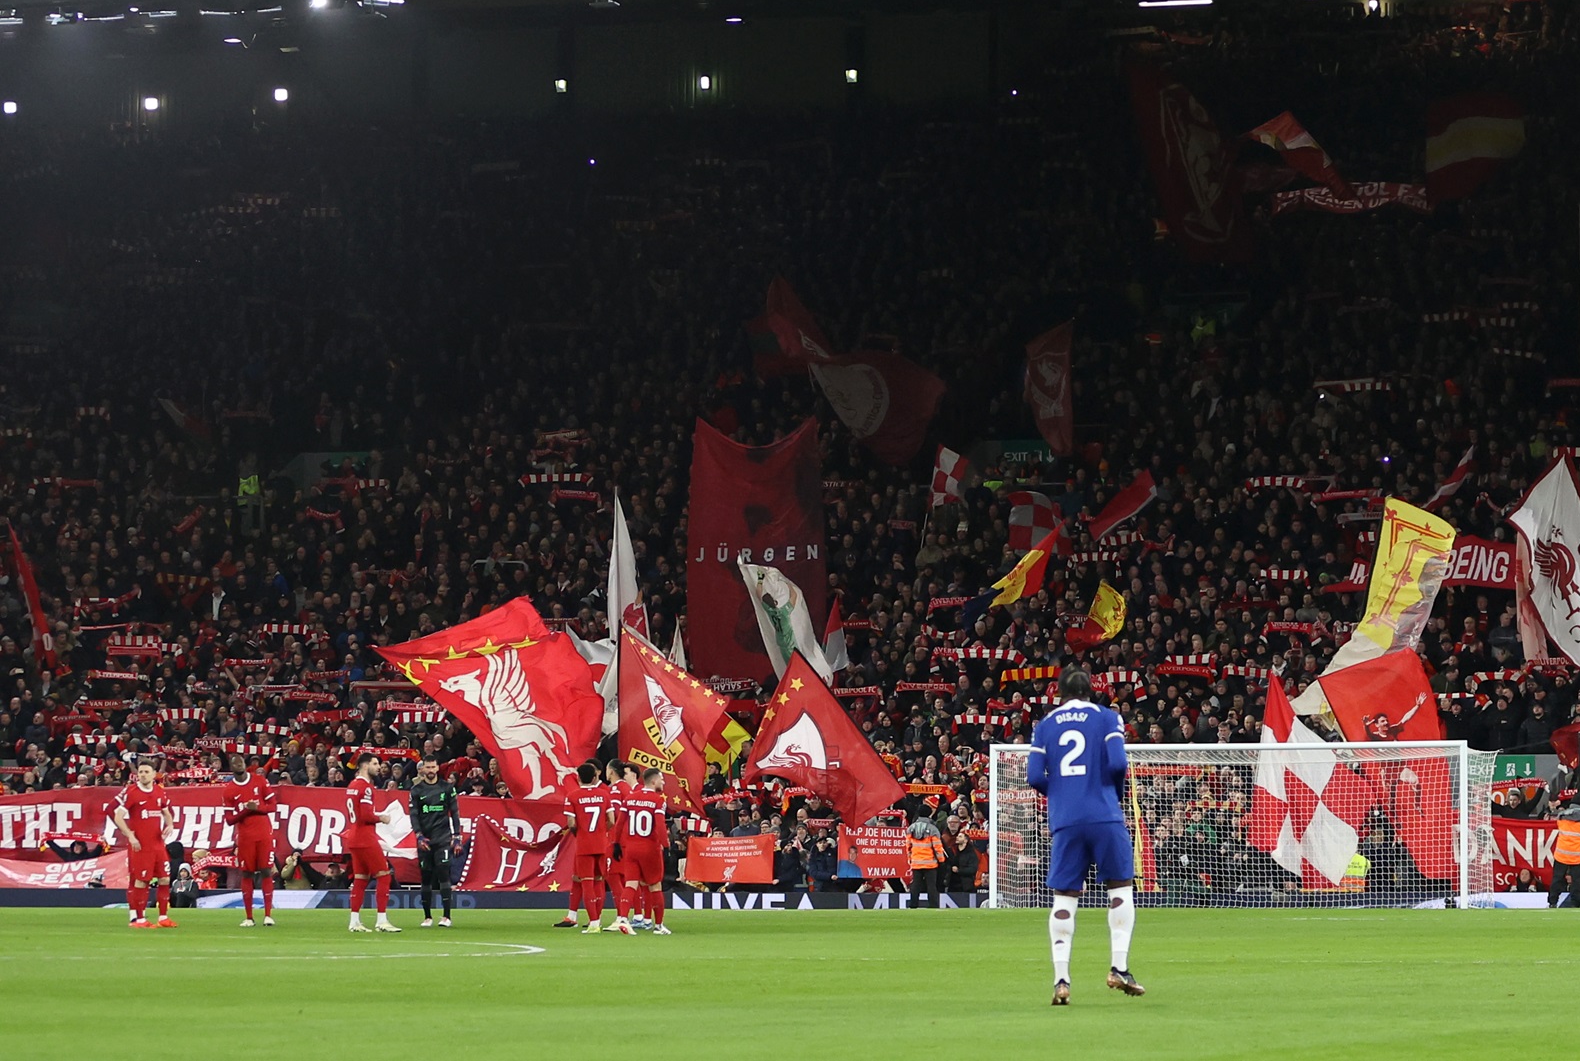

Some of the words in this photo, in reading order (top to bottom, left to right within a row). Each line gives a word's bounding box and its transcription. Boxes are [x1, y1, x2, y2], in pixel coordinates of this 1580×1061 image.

[694, 542, 820, 562] JÜRGEN
[1446, 545, 1510, 582] BEING
[1055, 713, 1088, 723] DISASI
[209, 739, 234, 747] SALH
[1058, 730, 1087, 776] 2
[347, 798, 356, 824] 8
[584, 806, 601, 832] 7
[0, 802, 82, 851] THE
[629, 810, 653, 837] 10
[864, 828, 879, 837] JOE
[46, 858, 97, 874] GIVE
[226, 855, 233, 863] FC
[29, 869, 104, 884] PEACE
[672, 893, 815, 910] NIVEA
